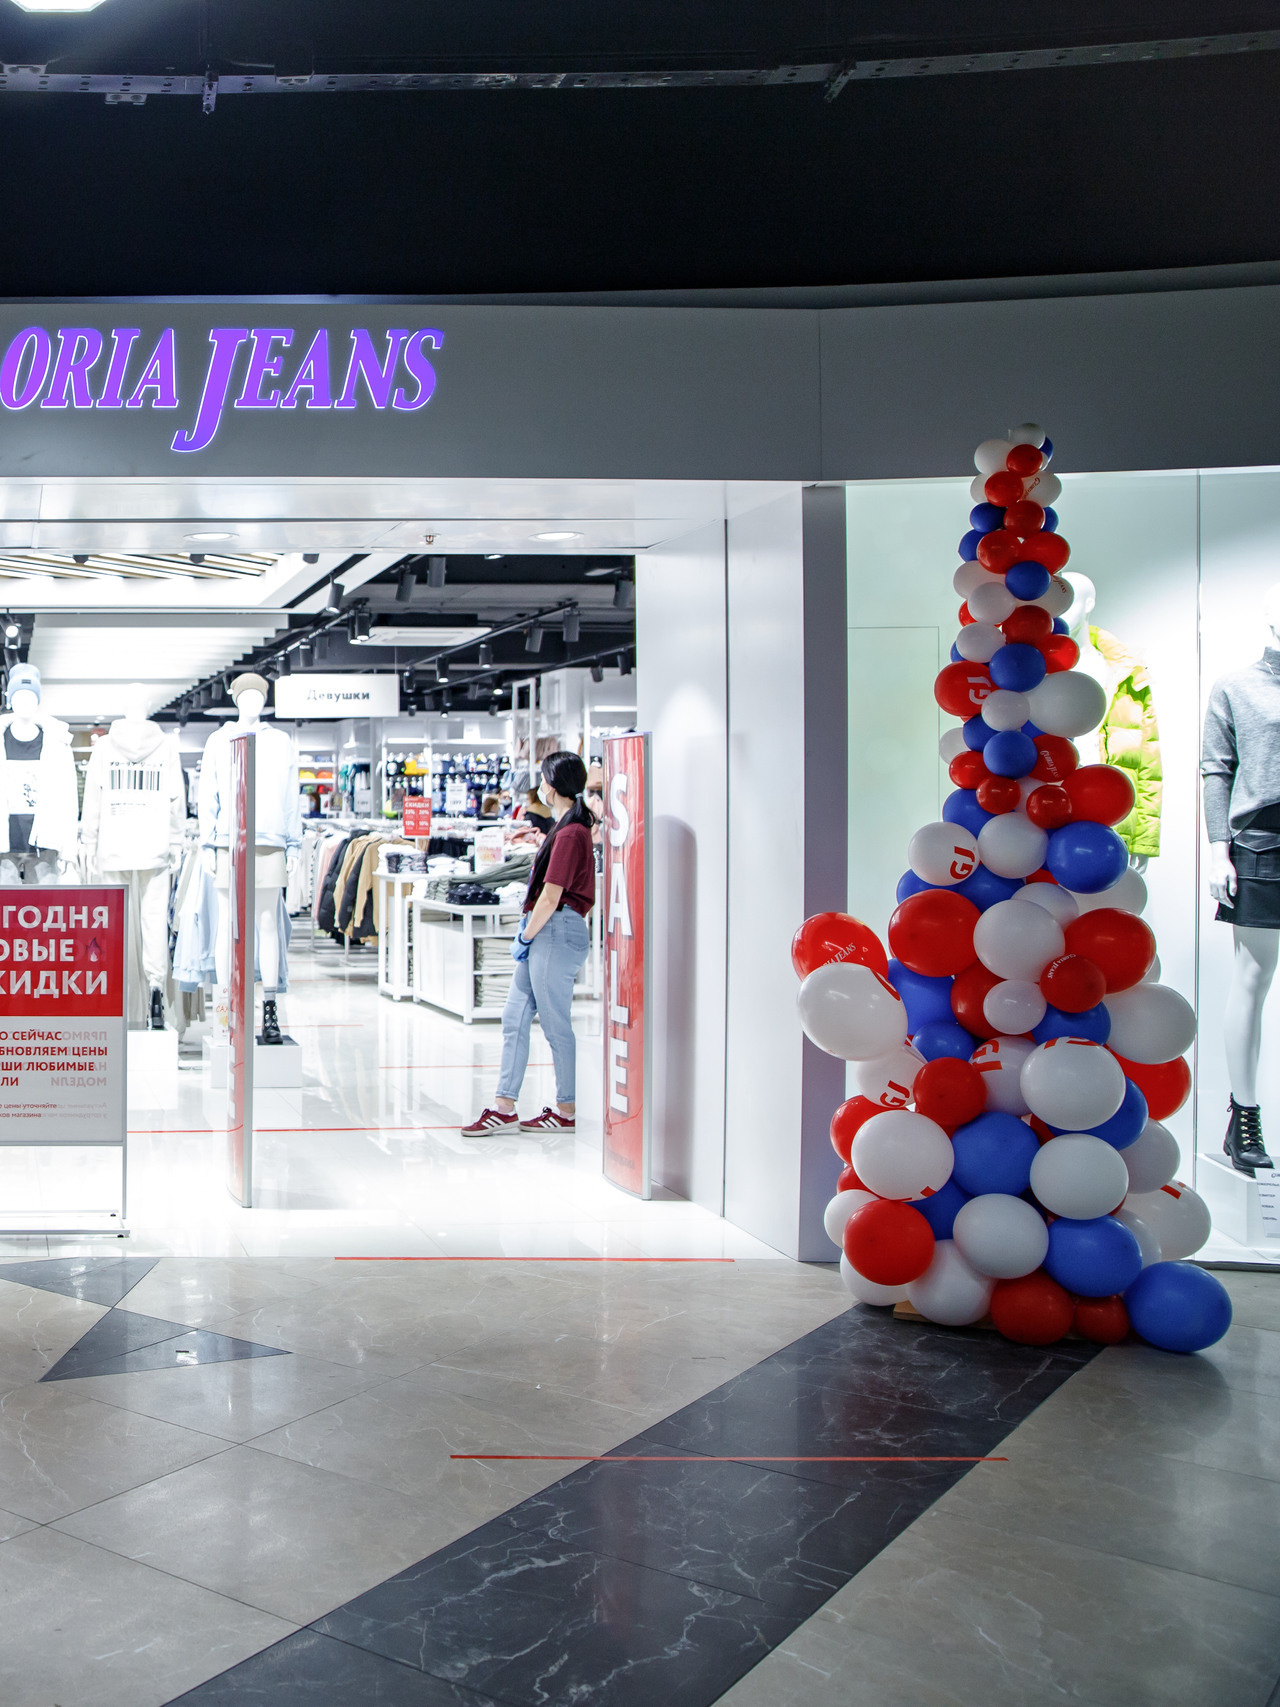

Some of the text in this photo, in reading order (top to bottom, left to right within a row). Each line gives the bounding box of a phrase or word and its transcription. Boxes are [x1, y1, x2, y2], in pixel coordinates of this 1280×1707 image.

[306, 689, 370, 702] Девушки
[949, 845, 976, 880] GJ
[12, 1029, 62, 1041] СЕЙЧАС
[72, 1046, 108, 1057] ЦЕНЫ
[26, 1061, 95, 1071] ЛЮБИМЫЕ
[880, 1080, 910, 1108] GJ
[22, 1102, 58, 1111] уточняйте
